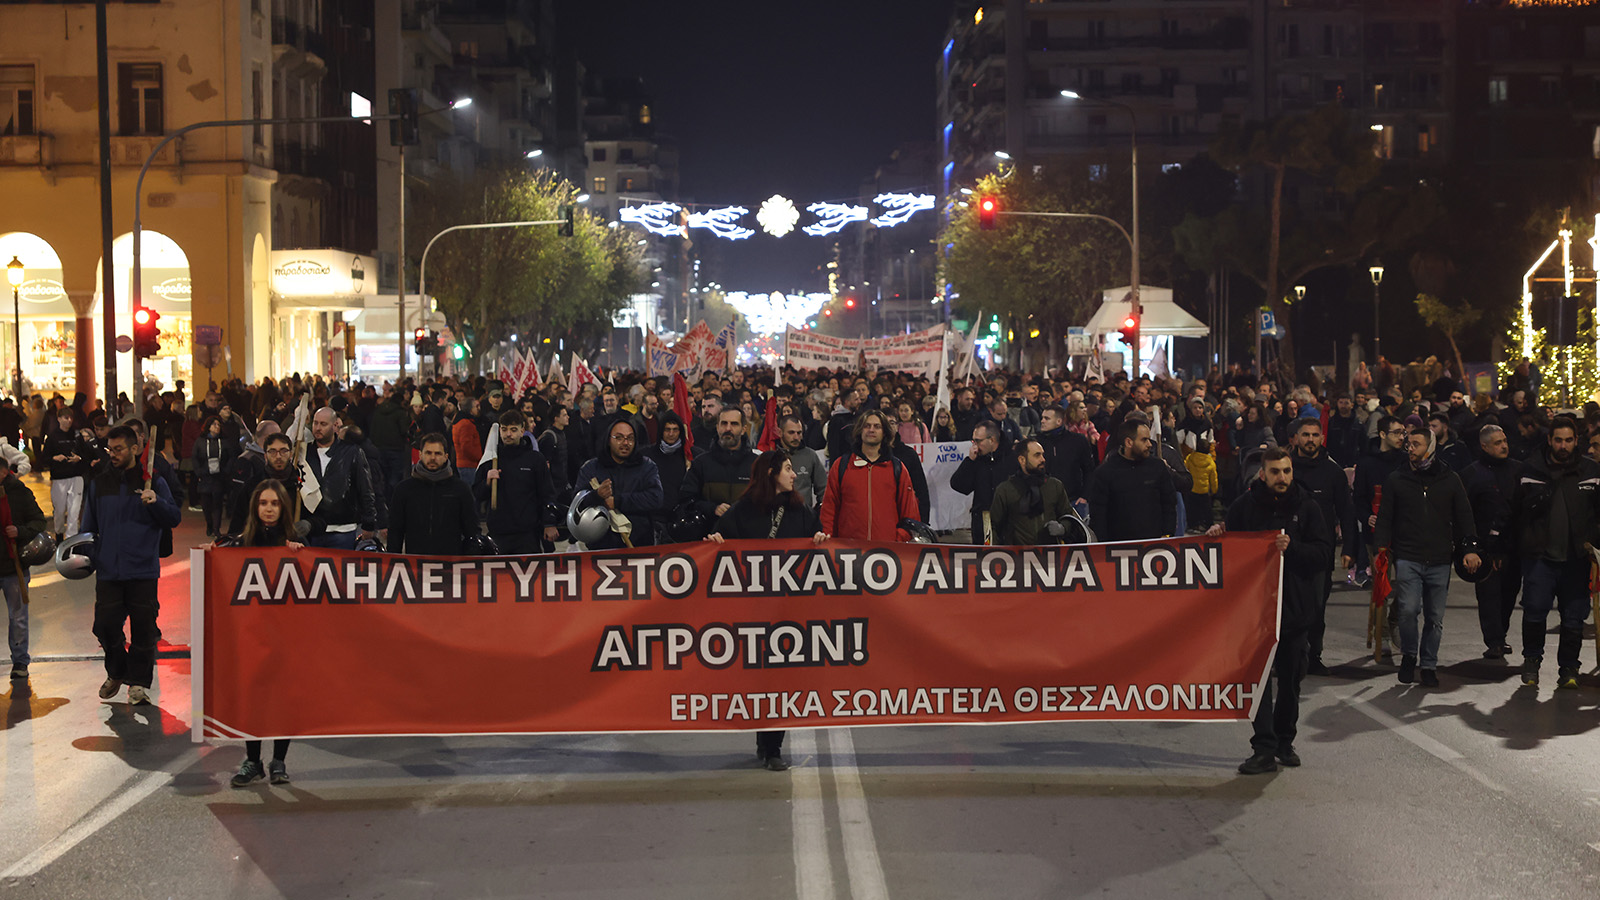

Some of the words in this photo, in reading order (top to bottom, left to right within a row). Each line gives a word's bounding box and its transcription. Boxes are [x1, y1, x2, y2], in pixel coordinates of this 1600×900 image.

[1261, 313, 1271, 328] P
[233, 557, 579, 603] ΑΛΛΗΛΕΓΓΥΗ
[594, 554, 696, 598] ΣΤΟ
[709, 550, 900, 595] ΔΙΚΑΙΟ
[911, 548, 1100, 592] ΑΓΩΝΑ
[1108, 545, 1220, 589] ΤΩΝ
[594, 620, 867, 669] ΑΓΡΟΤΩΝ!
[670, 690, 826, 721] ΕΡΓΑΤΙΚΑ
[832, 687, 1007, 716] ΣΩΜΑΤΕΙΑ
[1013, 683, 1257, 713] ΘΕΣΣΑΛΟΝΙΚΗ
